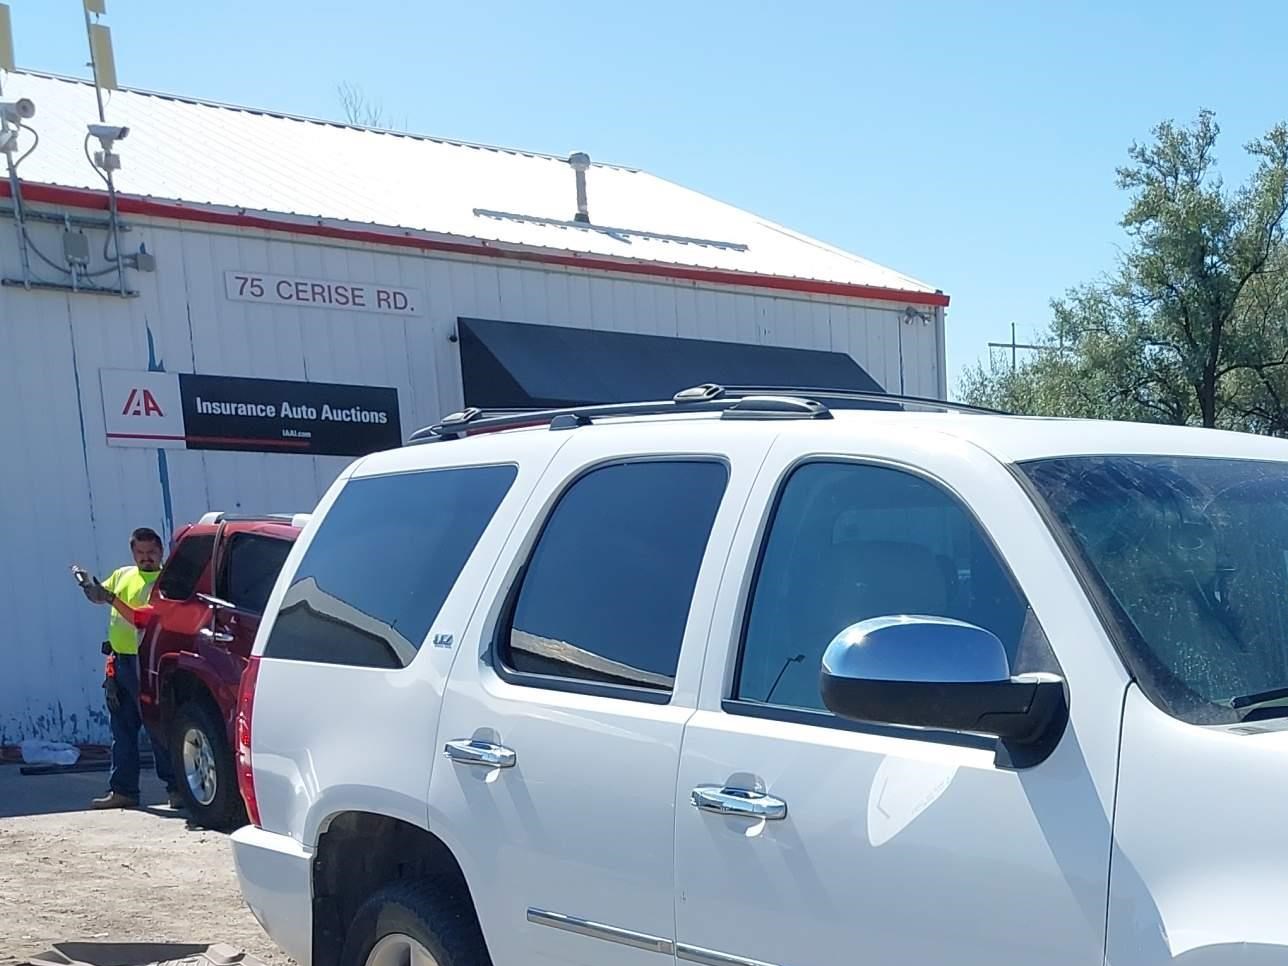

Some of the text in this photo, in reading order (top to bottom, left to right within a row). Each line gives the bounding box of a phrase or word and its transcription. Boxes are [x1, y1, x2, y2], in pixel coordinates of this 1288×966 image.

[235, 275, 415, 312] 75 CERISE RD.
[196, 396, 388, 425] Insurance Auto Auctions
